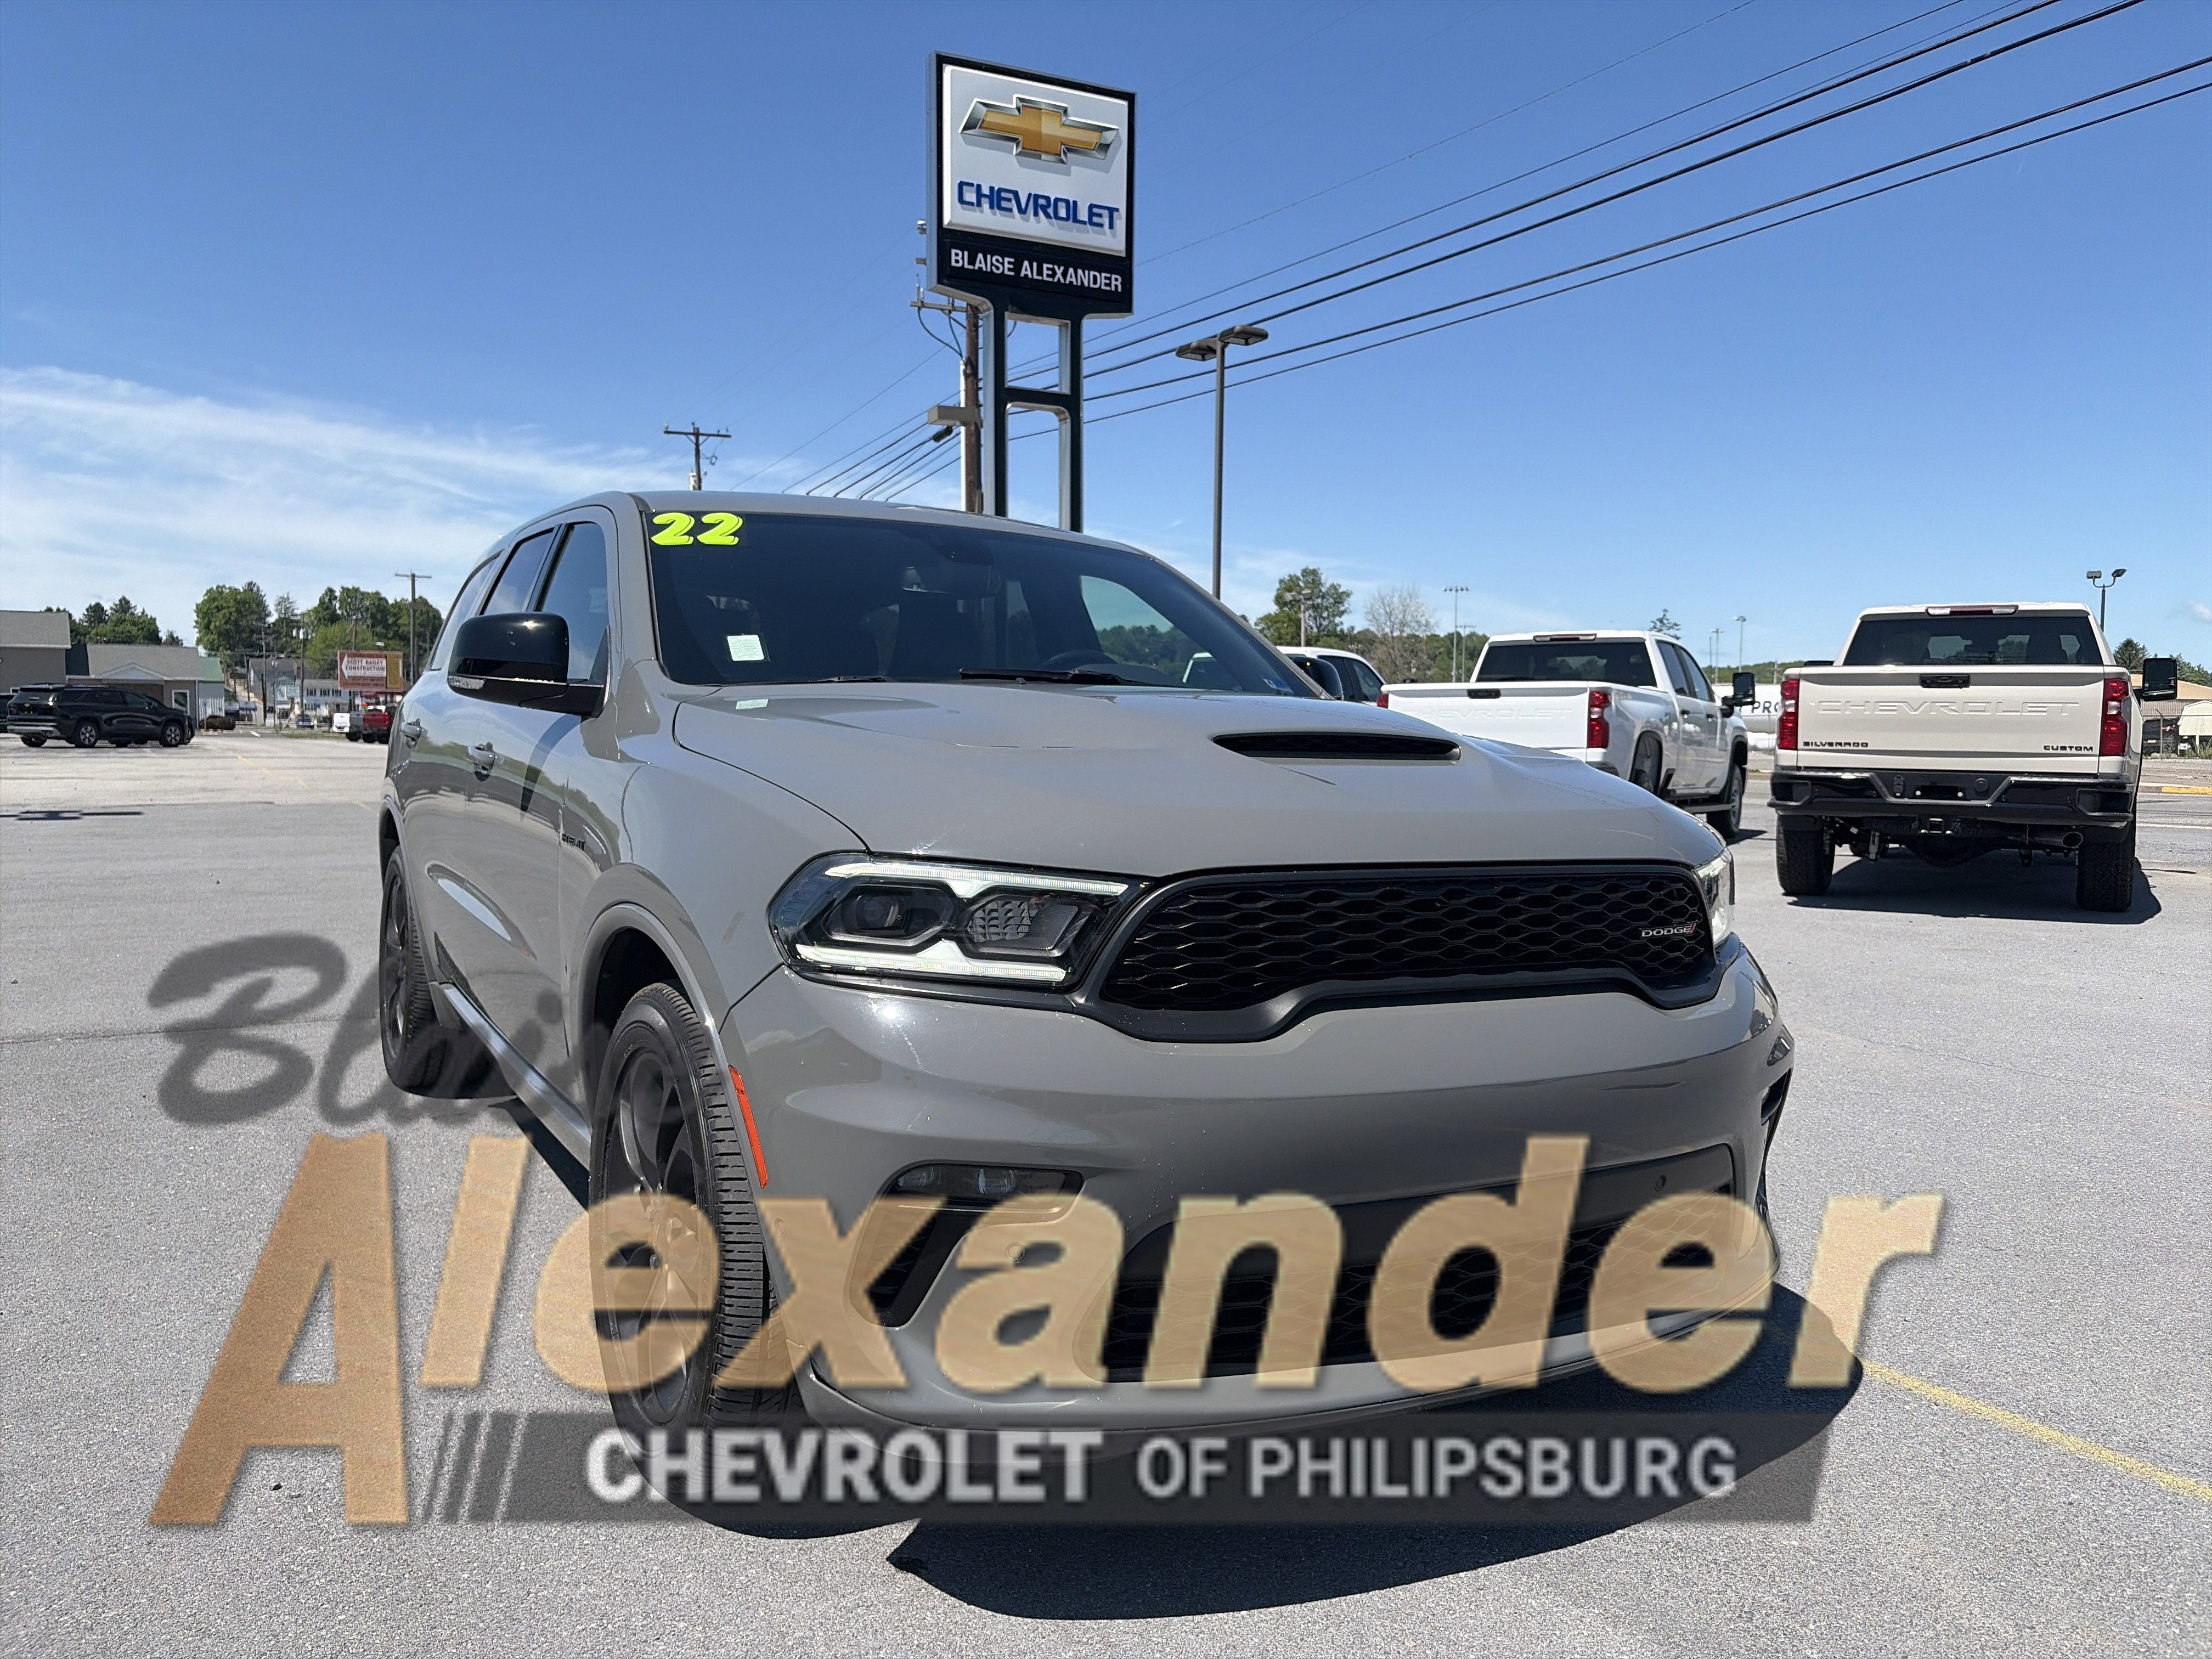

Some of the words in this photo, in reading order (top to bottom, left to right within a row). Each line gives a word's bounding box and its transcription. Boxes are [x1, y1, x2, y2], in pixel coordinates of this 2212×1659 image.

[957, 180, 1120, 230] CHEVROLET
[951, 249, 1015, 276] BLAISE
[1020, 260, 1122, 292] ALEXANDER
[651, 512, 743, 545] 22
[1817, 701, 2080, 715] CHEVROLET
[1641, 926, 1691, 937] DODGE
